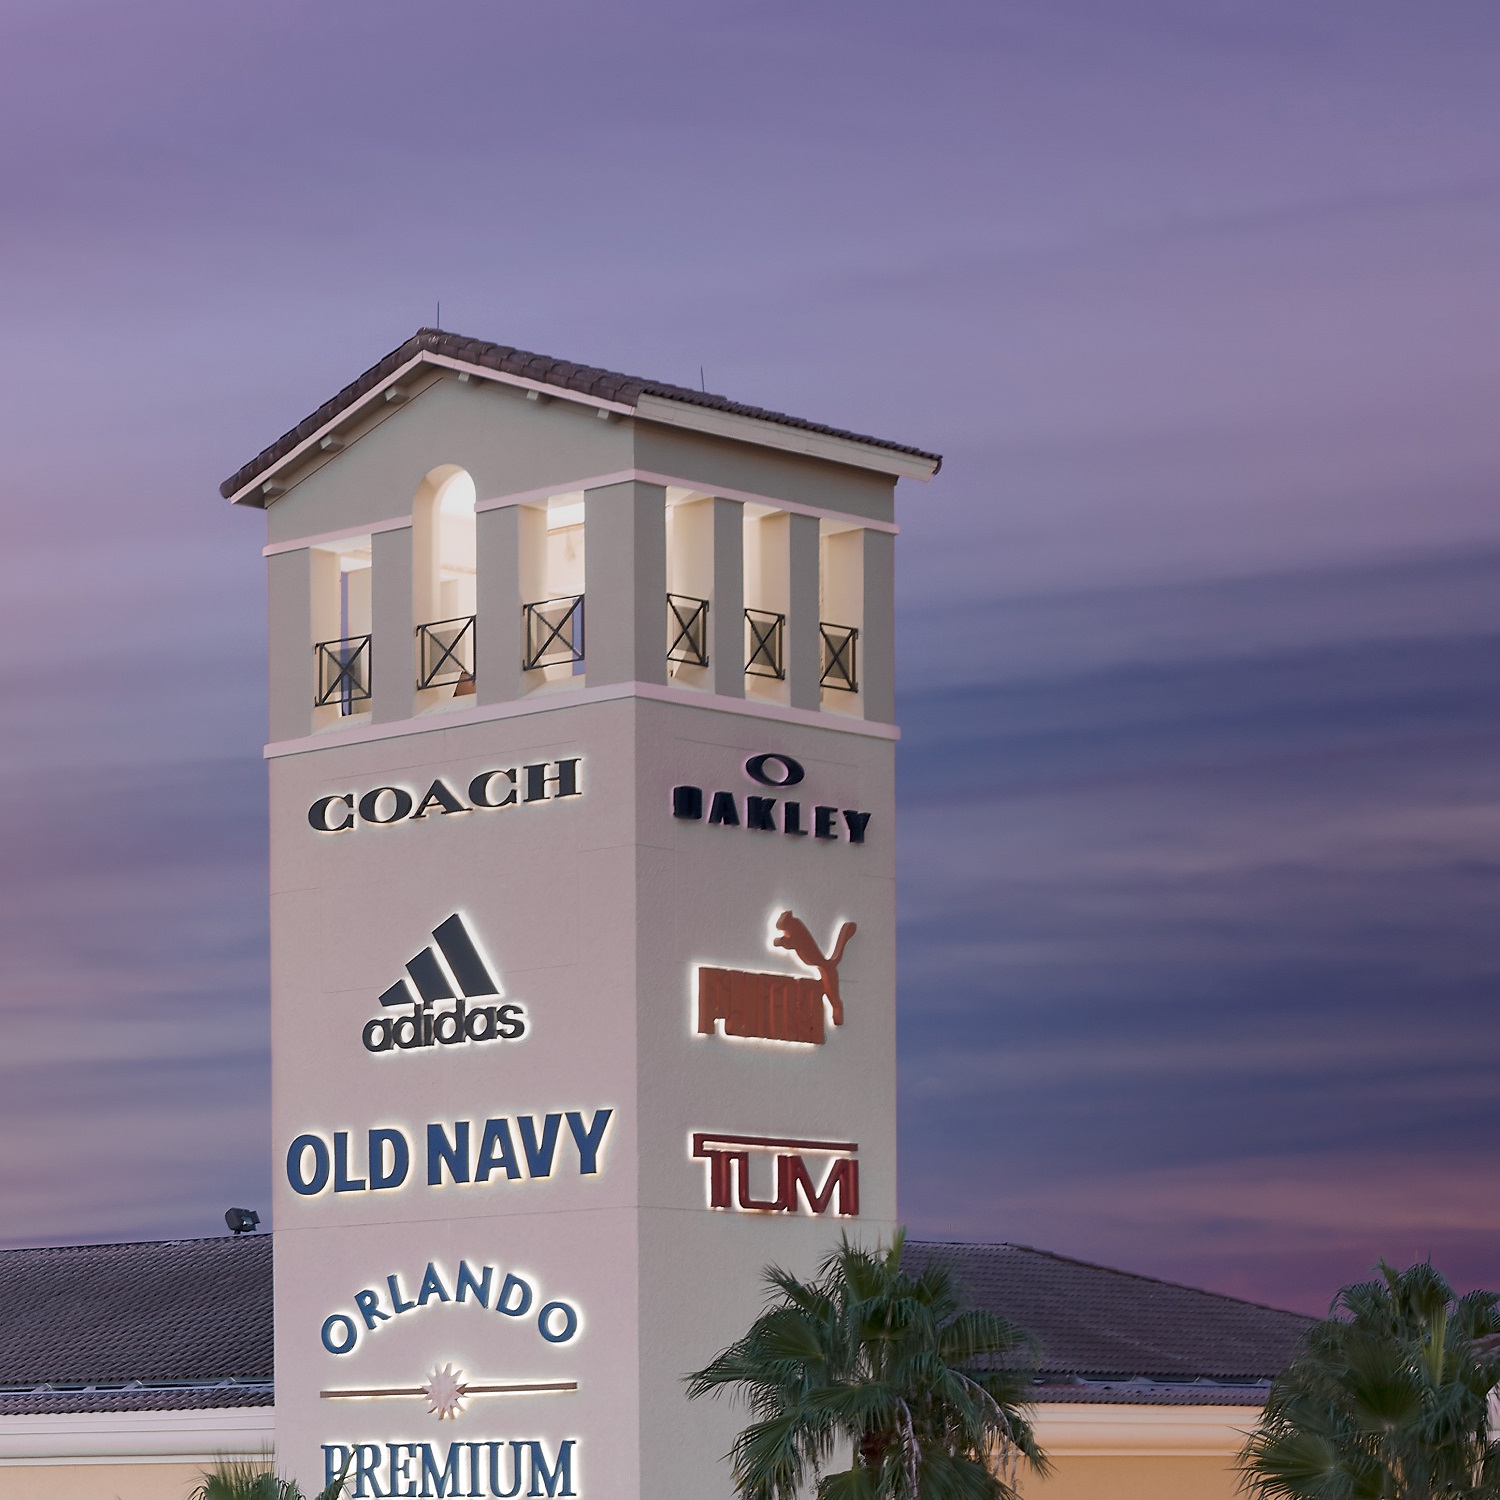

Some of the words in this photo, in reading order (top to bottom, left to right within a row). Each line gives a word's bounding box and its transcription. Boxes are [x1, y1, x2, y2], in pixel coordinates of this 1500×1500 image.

[308, 757, 583, 833] COACH
[673, 785, 871, 843] OAKLEY
[362, 996, 525, 1052] adidas
[286, 1128, 408, 1195] OLD
[427, 1109, 613, 1187] NAVY
[320, 1260, 578, 1355] ORLANDO
[320, 1440, 577, 1498] PREMIUM
